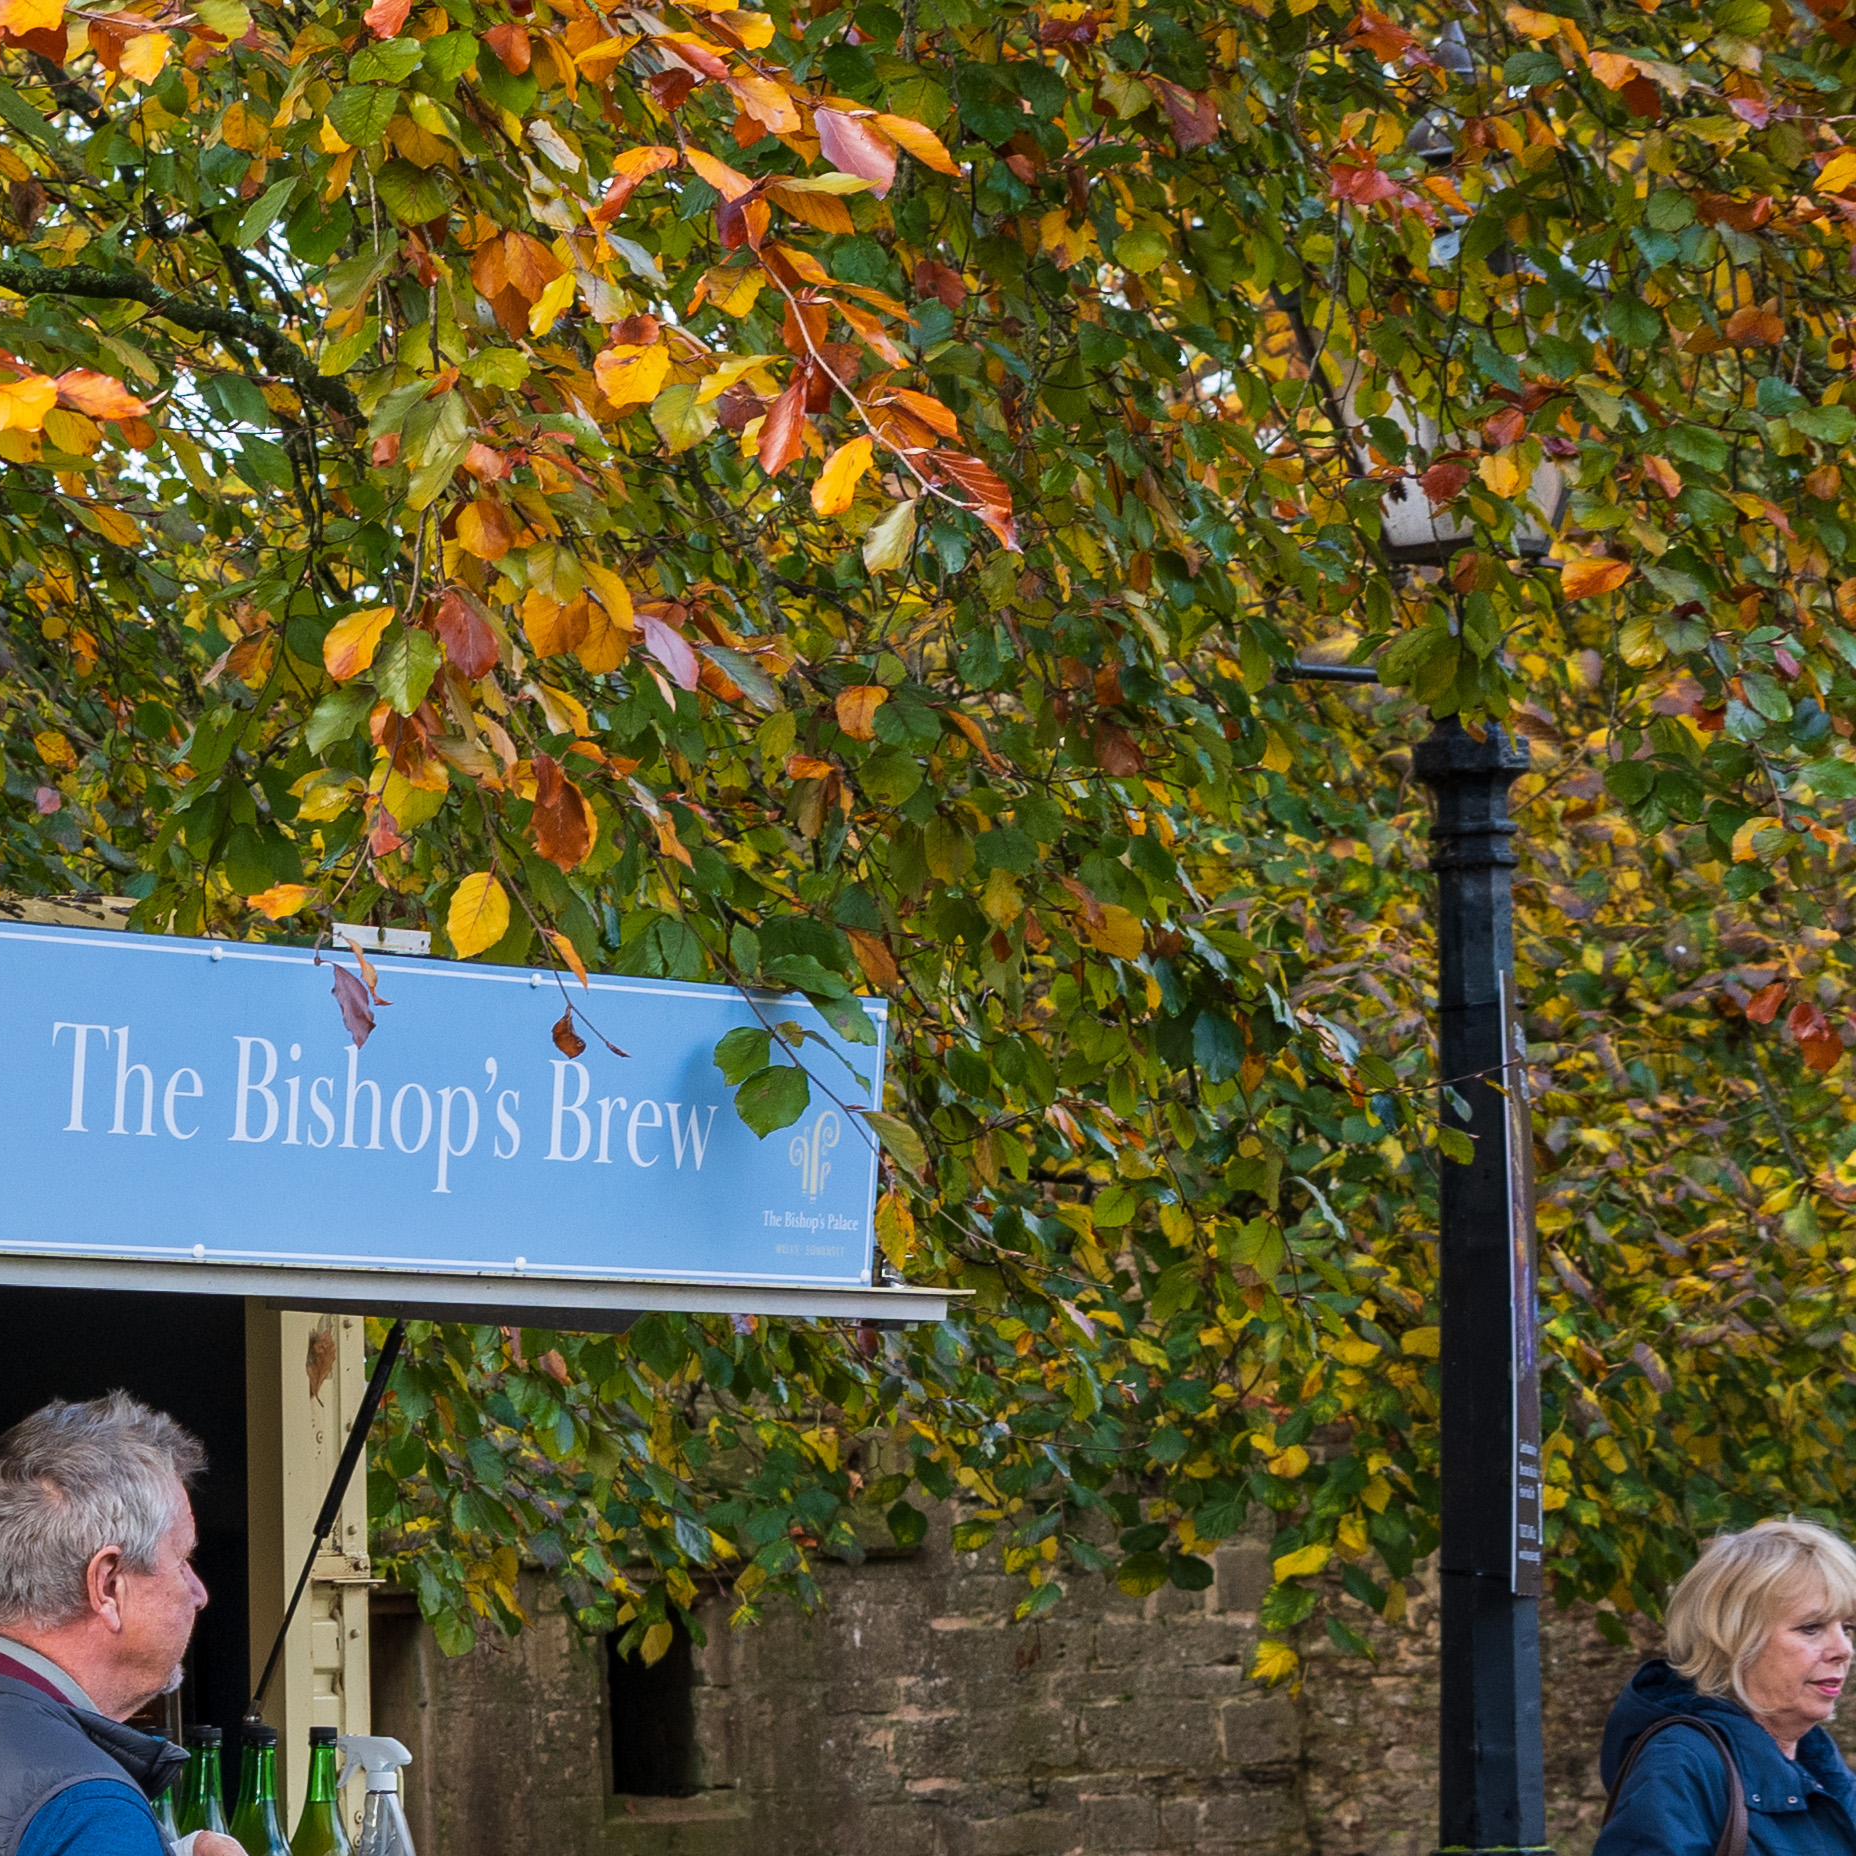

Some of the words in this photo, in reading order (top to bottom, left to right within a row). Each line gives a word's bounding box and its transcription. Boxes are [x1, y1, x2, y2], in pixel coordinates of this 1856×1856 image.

[50, 1020, 202, 1141] The
[228, 1032, 522, 1194] Bishop's
[542, 1058, 719, 1174] Brew
[762, 1209, 782, 1228] The
[784, 1211, 825, 1234] Bishop's
[827, 1213, 859, 1232] Palace
